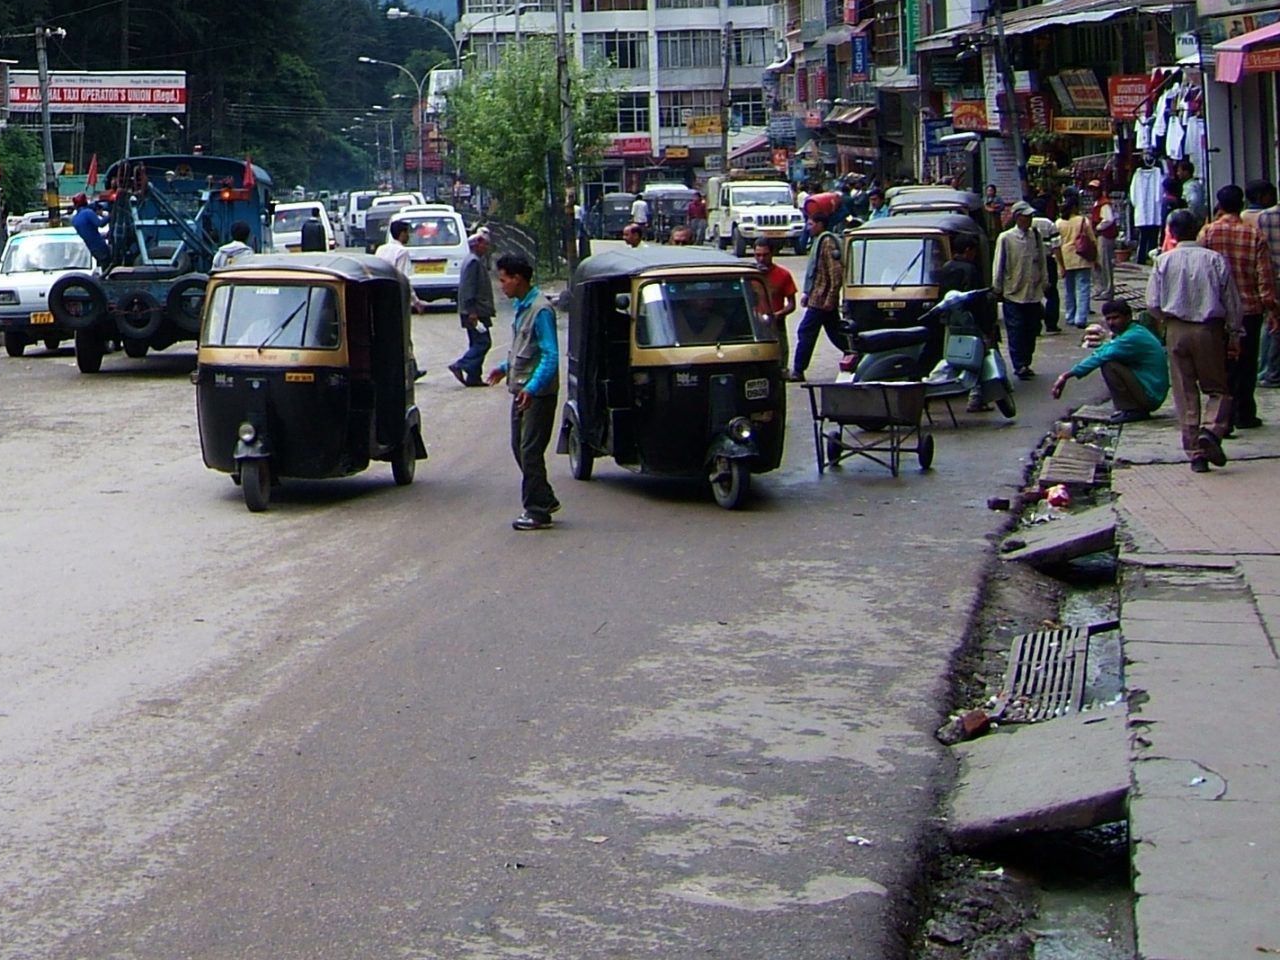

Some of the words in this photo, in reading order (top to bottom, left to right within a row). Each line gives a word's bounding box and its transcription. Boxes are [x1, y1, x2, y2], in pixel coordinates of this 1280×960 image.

[63, 88, 80, 101] TAXI
[81, 88, 126, 102] OPERATOR'S
[127, 89, 152, 102] UNION
